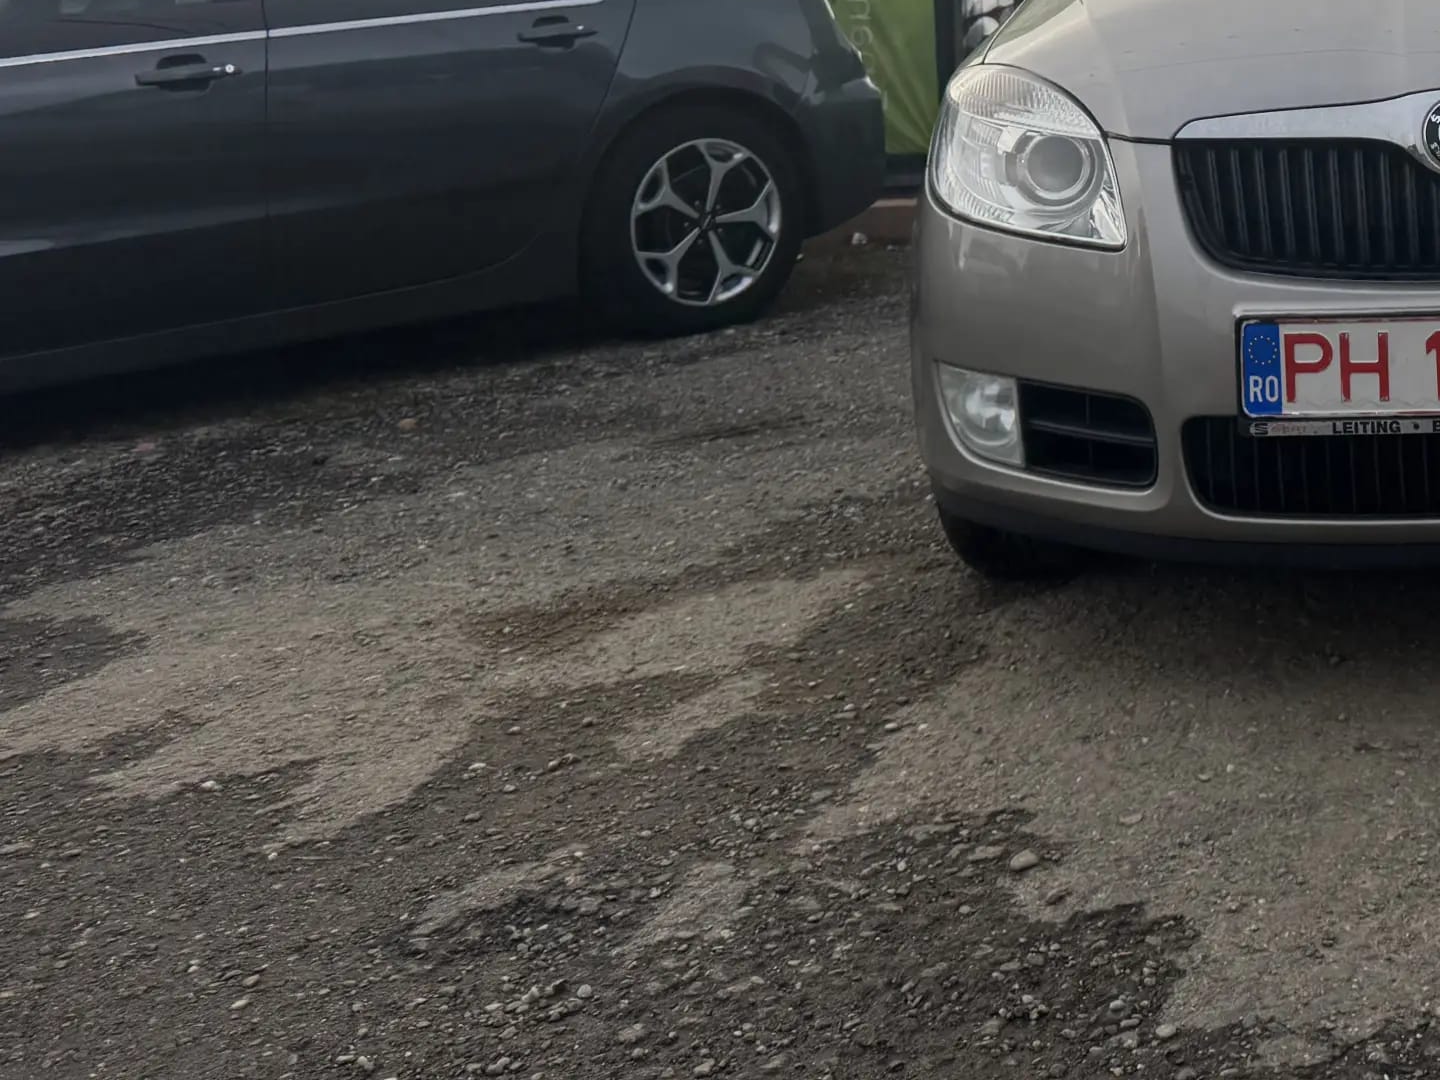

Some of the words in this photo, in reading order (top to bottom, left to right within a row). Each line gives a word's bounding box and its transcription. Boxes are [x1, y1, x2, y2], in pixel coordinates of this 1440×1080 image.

[1284, 331, 1391, 404] PH
[1249, 375, 1279, 404] RO
[1332, 420, 1401, 435] LEITING
